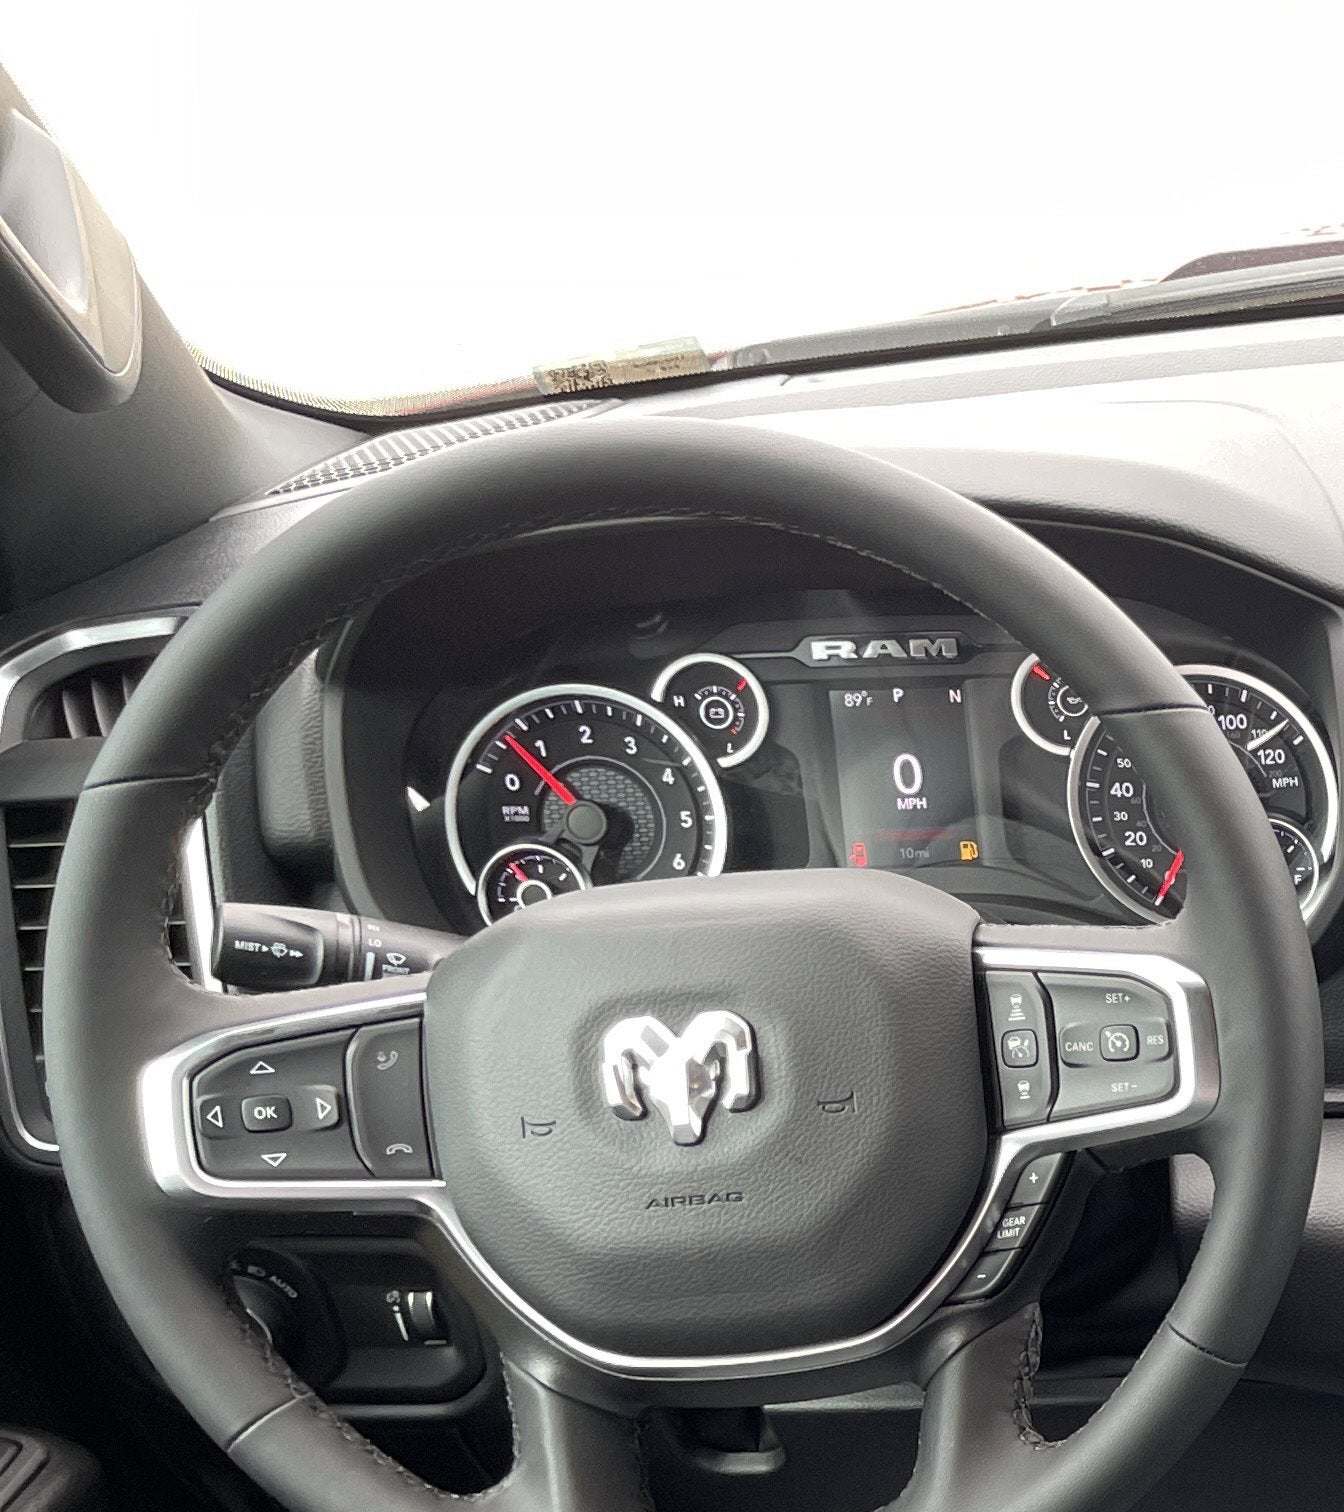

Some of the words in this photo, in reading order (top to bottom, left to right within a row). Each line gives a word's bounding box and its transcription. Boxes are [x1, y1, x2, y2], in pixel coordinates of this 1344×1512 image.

[811, 638, 958, 660] RAM
[673, 695, 685, 707] H
[892, 688, 904, 702] P
[949, 689, 962, 703] N
[1217, 713, 1247, 730] 100
[578, 725, 594, 744] 2
[1063, 730, 1071, 740] L
[535, 739, 546, 758] 1
[624, 736, 638, 755] 3
[726, 742, 734, 753] L
[1116, 758, 1131, 768] 50
[1257, 749, 1286, 765] 120
[662, 768, 675, 785] 4
[893, 753, 924, 796] 0
[504, 773, 521, 792] 0
[1272, 776, 1299, 789] MPH
[1110, 782, 1134, 798] 40
[502, 805, 530, 815] RPM
[897, 797, 928, 811] MPH
[680, 810, 693, 828] 5
[1113, 811, 1128, 821] 30
[1124, 831, 1147, 846] 20
[673, 853, 686, 870] 6
[1140, 858, 1153, 869] 10
[1293, 874, 1302, 885] F
[234, 940, 262, 952] MIST
[368, 938, 382, 948] LO
[1065, 1041, 1094, 1052] CANC
[1146, 1035, 1164, 1045] RES
[253, 1105, 278, 1119] OK
[645, 1191, 744, 1210] AIRBAG
[1002, 1216, 1026, 1227] GEAR
[997, 1228, 1021, 1239] LIMIT
